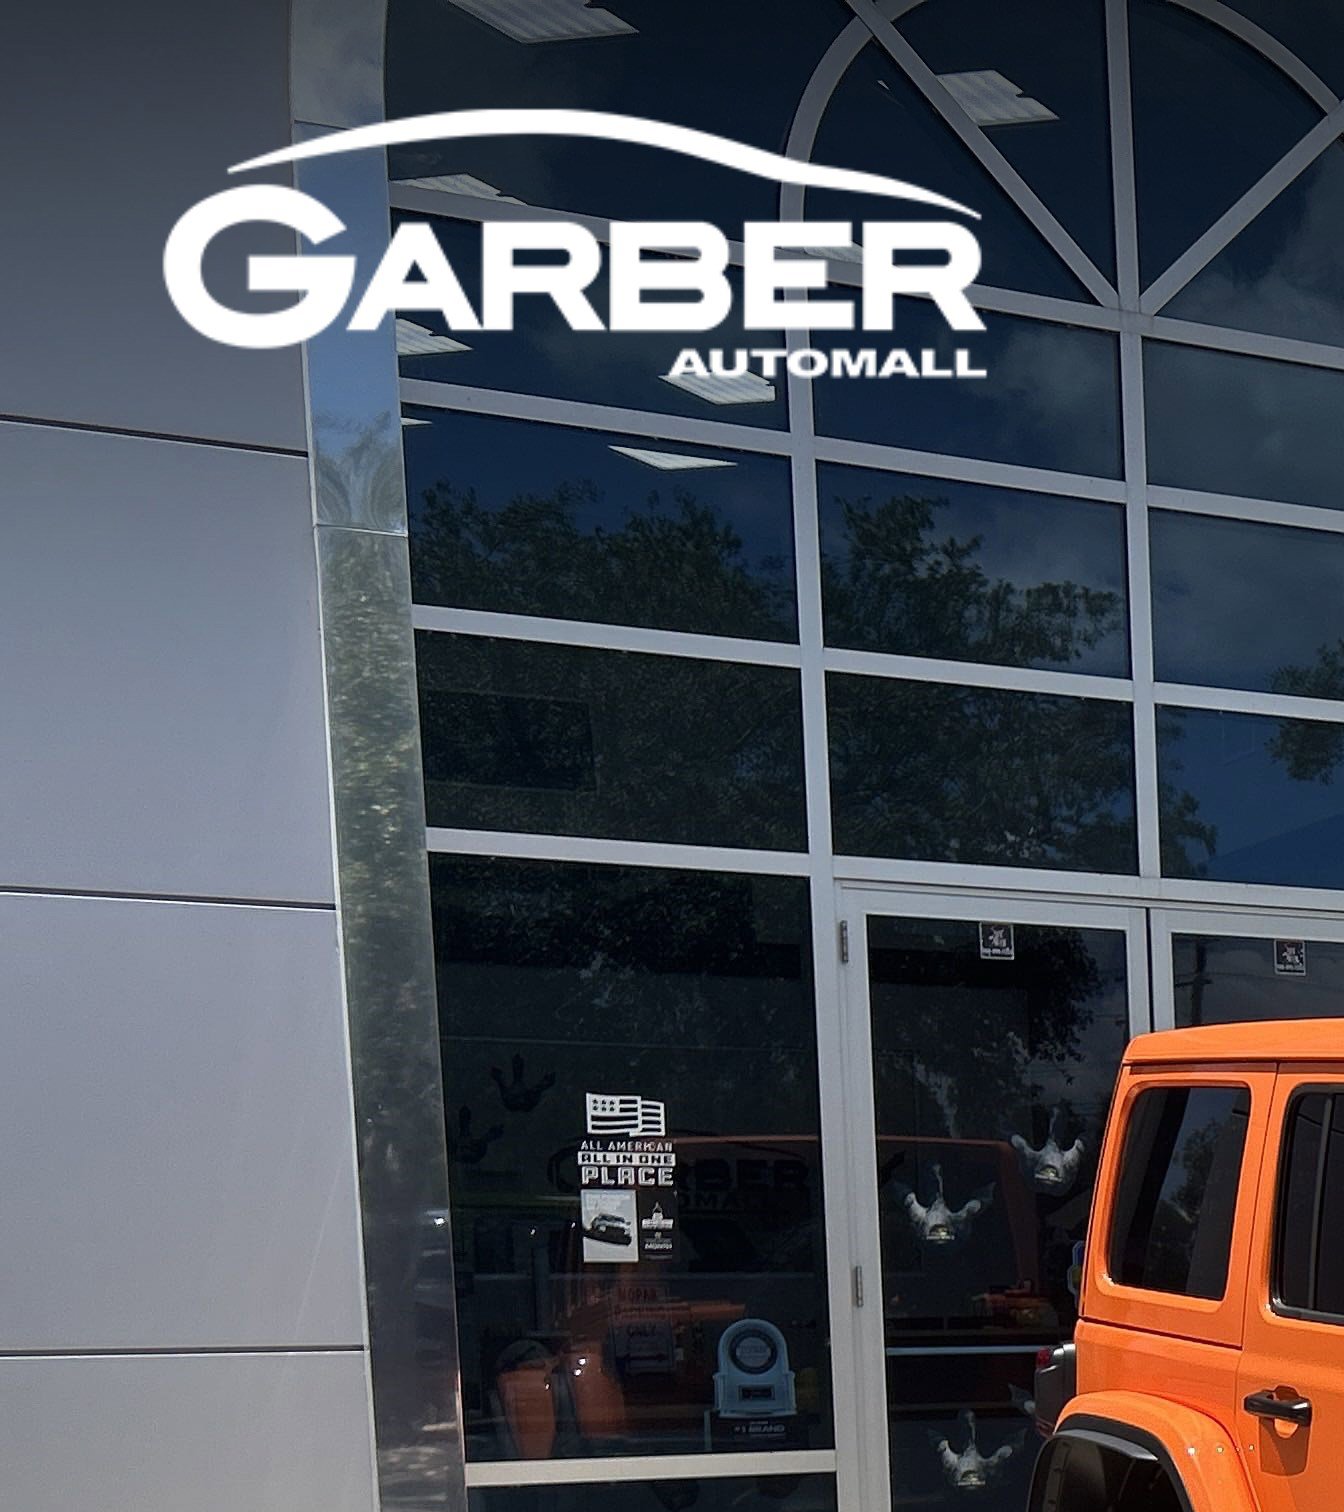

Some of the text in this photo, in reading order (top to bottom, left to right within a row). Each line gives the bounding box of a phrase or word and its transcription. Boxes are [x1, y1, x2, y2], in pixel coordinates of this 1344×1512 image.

[581, 1140, 673, 1152] ALL AMERICAN
[581, 1153, 673, 1164] ALL IN ONE
[581, 1166, 674, 1186] PLACE
